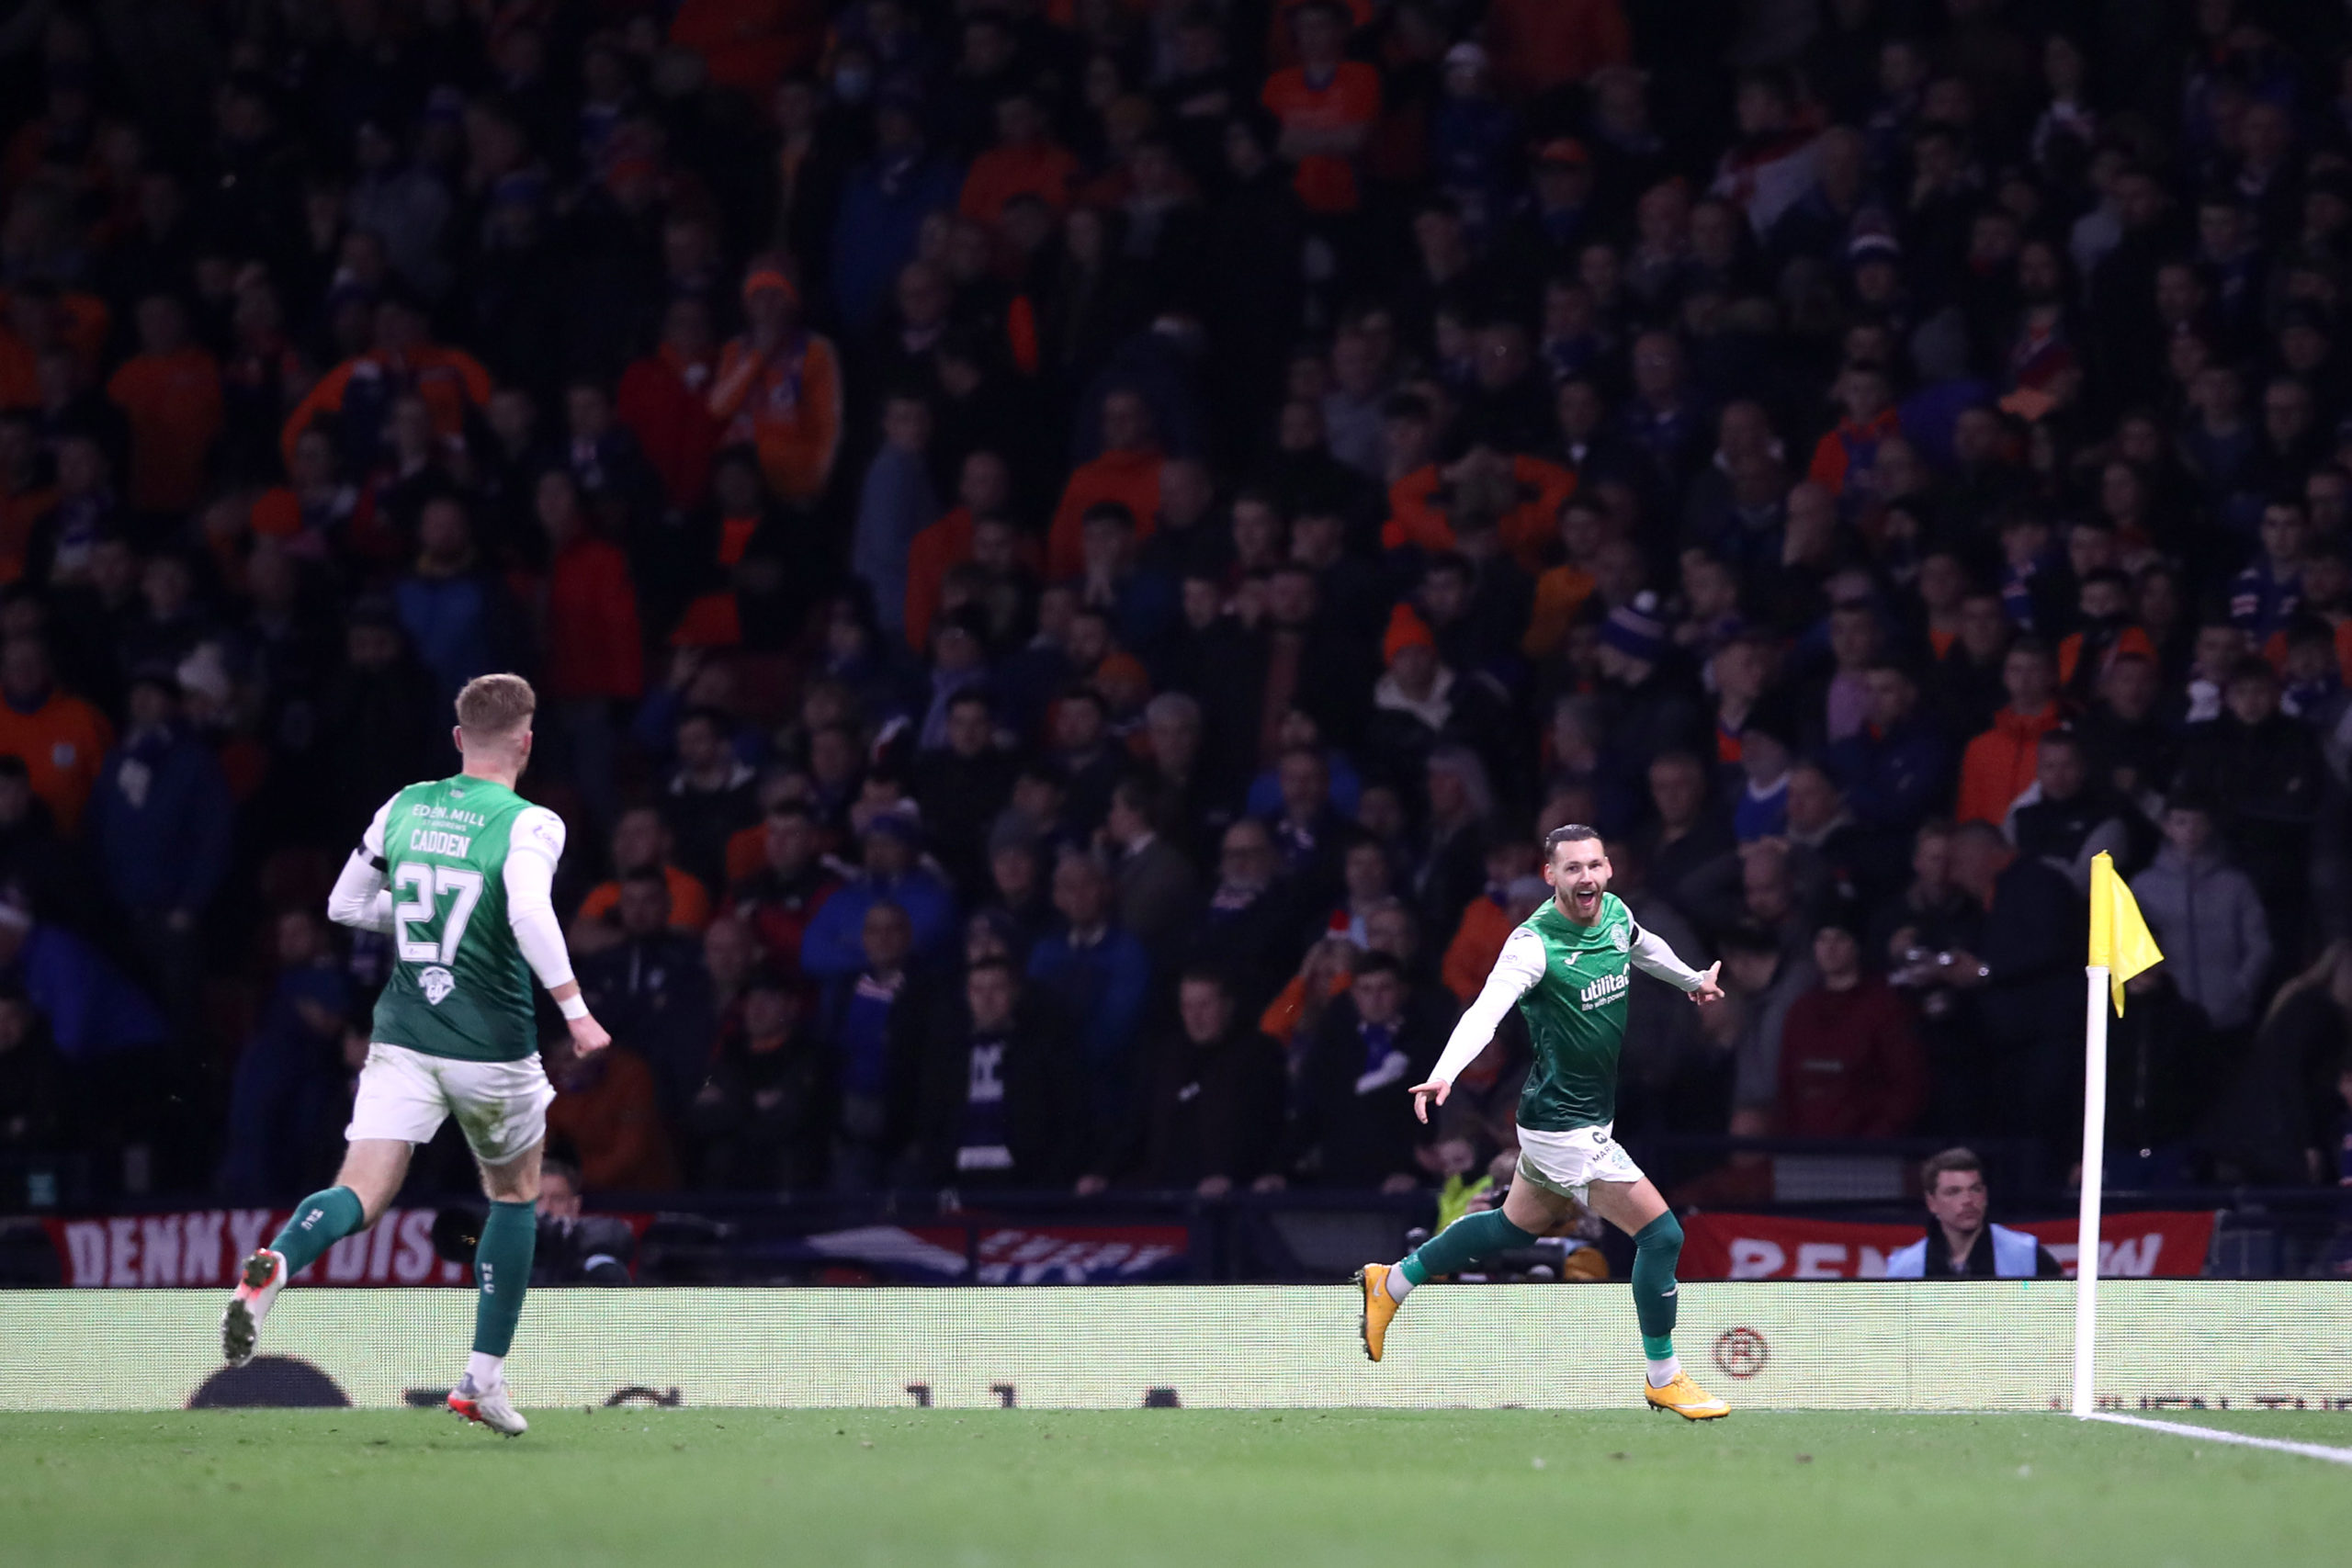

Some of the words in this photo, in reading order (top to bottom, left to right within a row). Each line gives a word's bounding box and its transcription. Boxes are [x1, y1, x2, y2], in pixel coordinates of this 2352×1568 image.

[410, 829, 471, 859] CADDEN
[395, 862, 484, 966] 27
[1580, 974, 1624, 1002] utilita
[65, 1208, 273, 1285] DENNY
[326, 1207, 462, 1284] DIS
